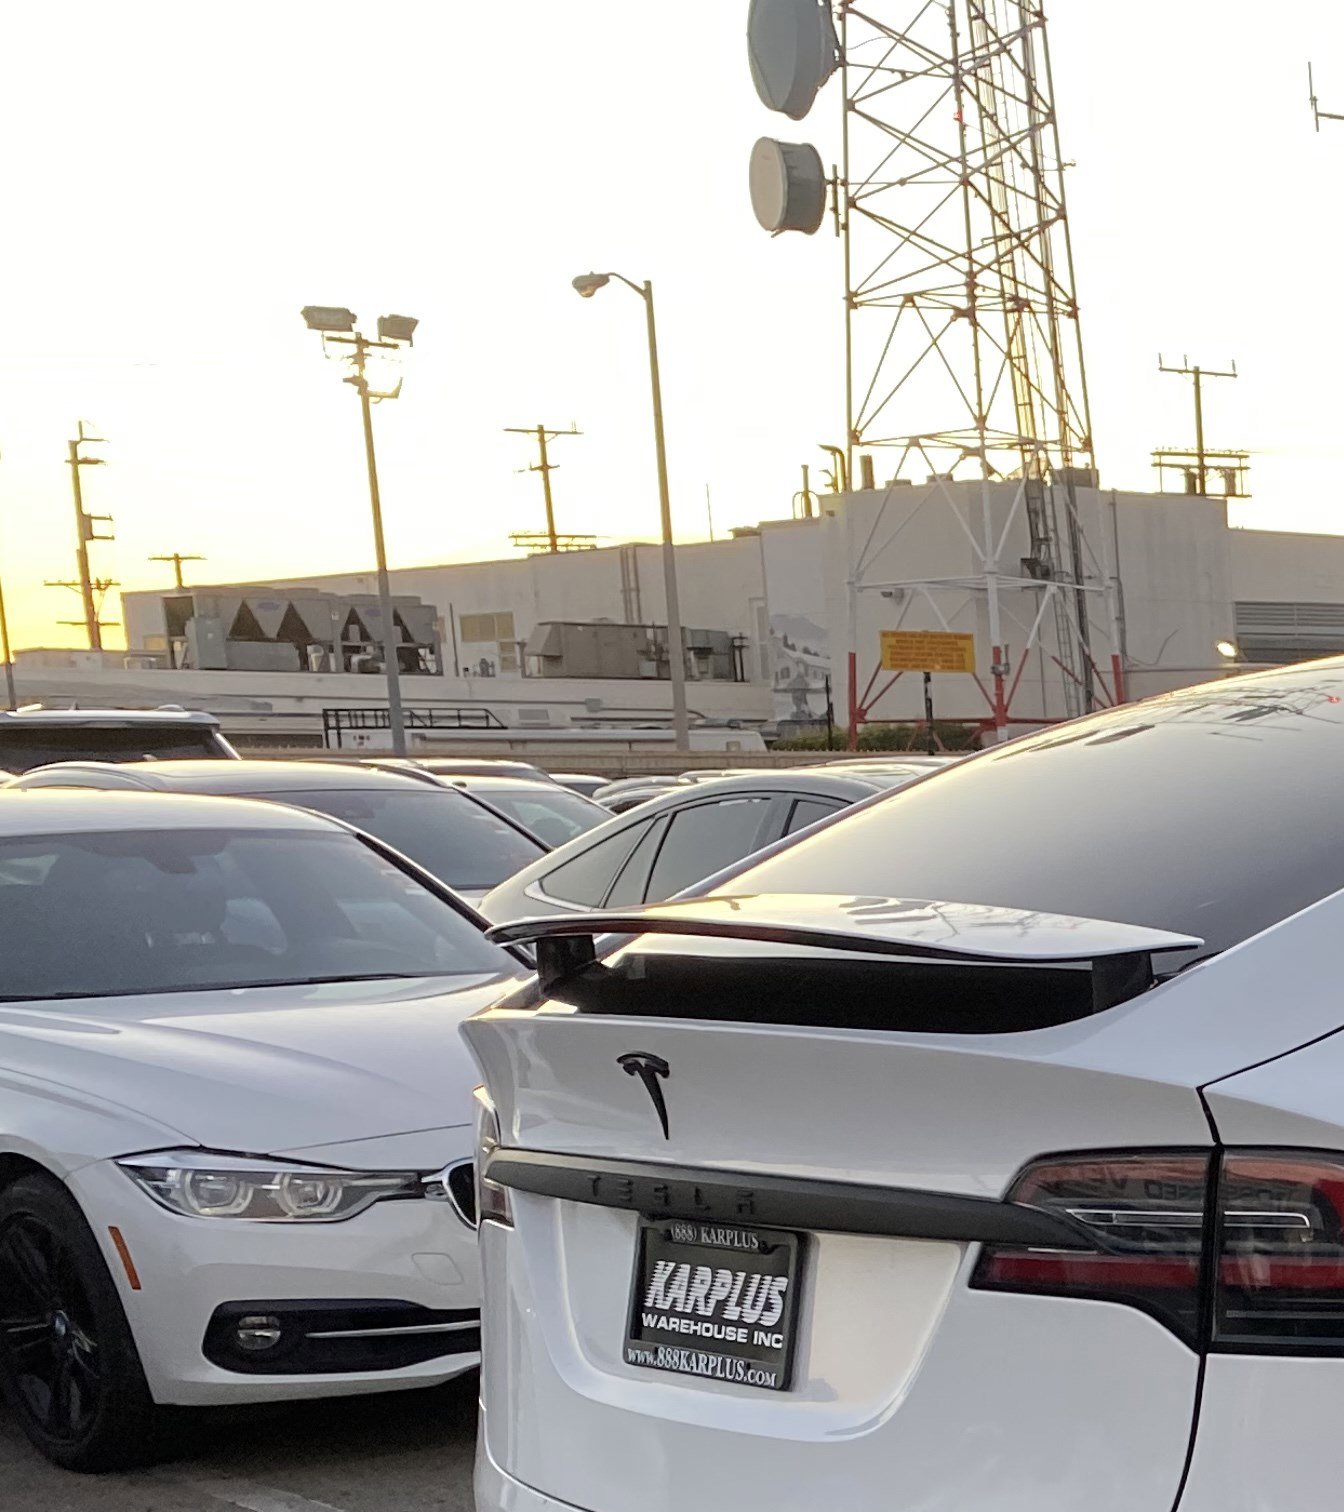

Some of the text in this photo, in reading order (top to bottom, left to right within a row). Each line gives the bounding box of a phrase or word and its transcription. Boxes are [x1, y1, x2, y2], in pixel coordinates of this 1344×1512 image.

[587, 1174, 753, 1214] TESLA
[671, 1223, 759, 1249] (888) KARPLUS
[643, 1260, 788, 1327] KARPLUS
[642, 1312, 783, 1349] WAREHOUSE INC
